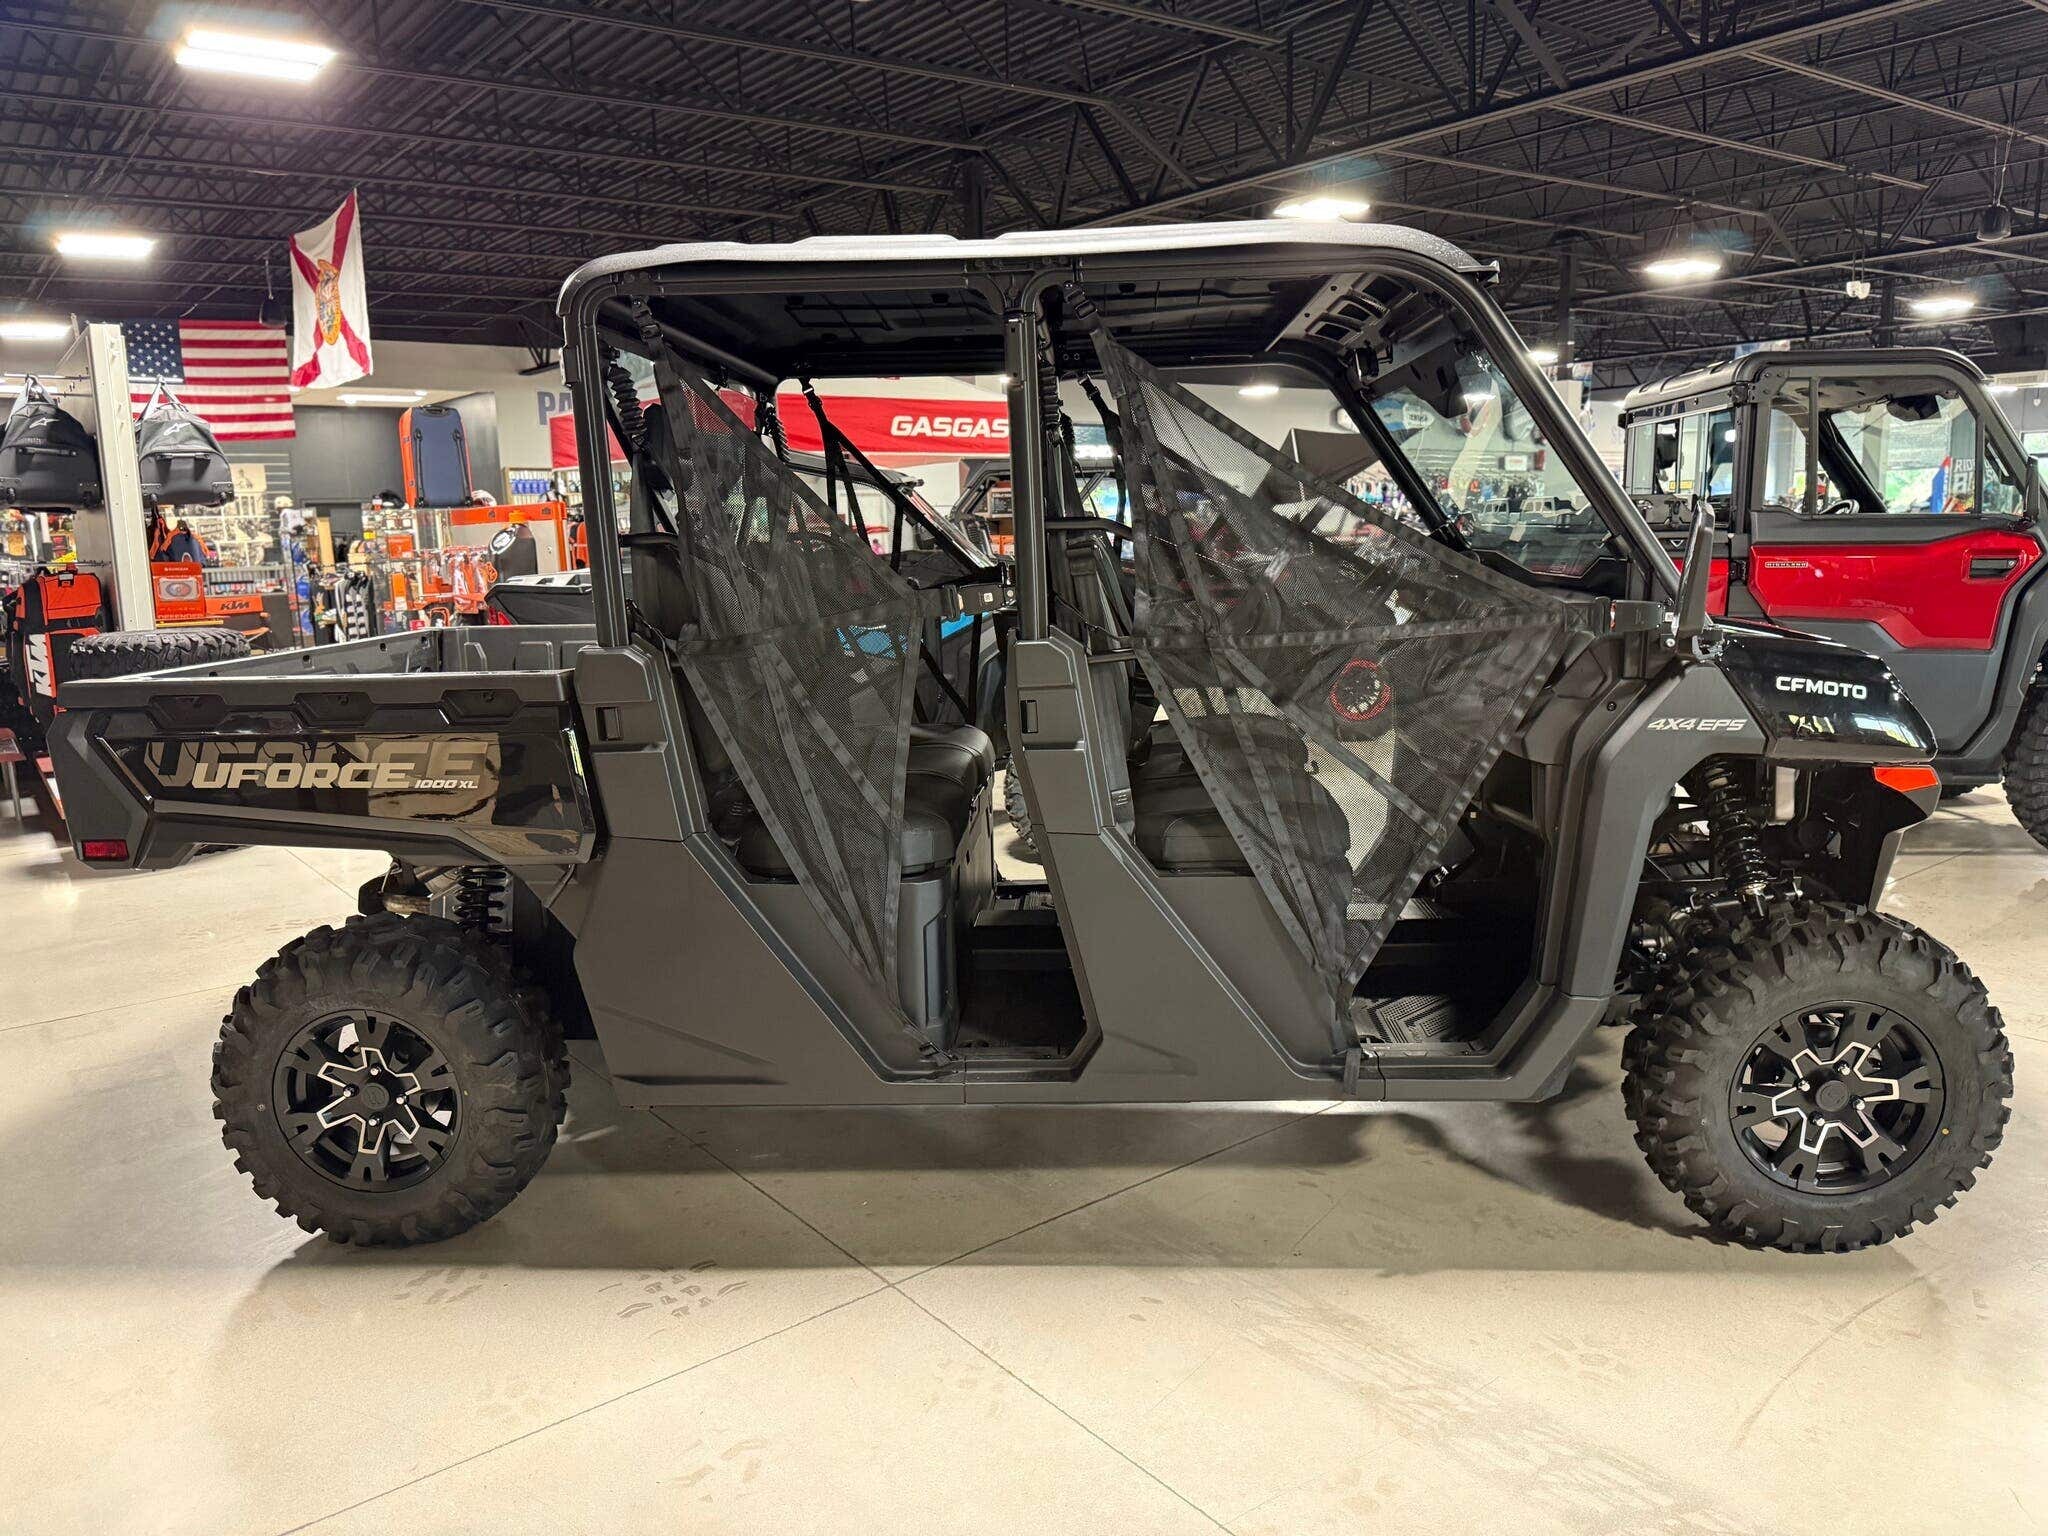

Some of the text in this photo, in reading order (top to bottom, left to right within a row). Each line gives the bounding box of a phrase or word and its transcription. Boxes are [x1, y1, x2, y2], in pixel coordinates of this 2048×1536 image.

[890, 415, 1009, 438] GASGAS
[219, 601, 251, 611] KTM
[26, 634, 53, 697] KTM
[1775, 676, 1868, 699] CFMOTO
[192, 762, 479, 789] UFORCE 1000 XL
